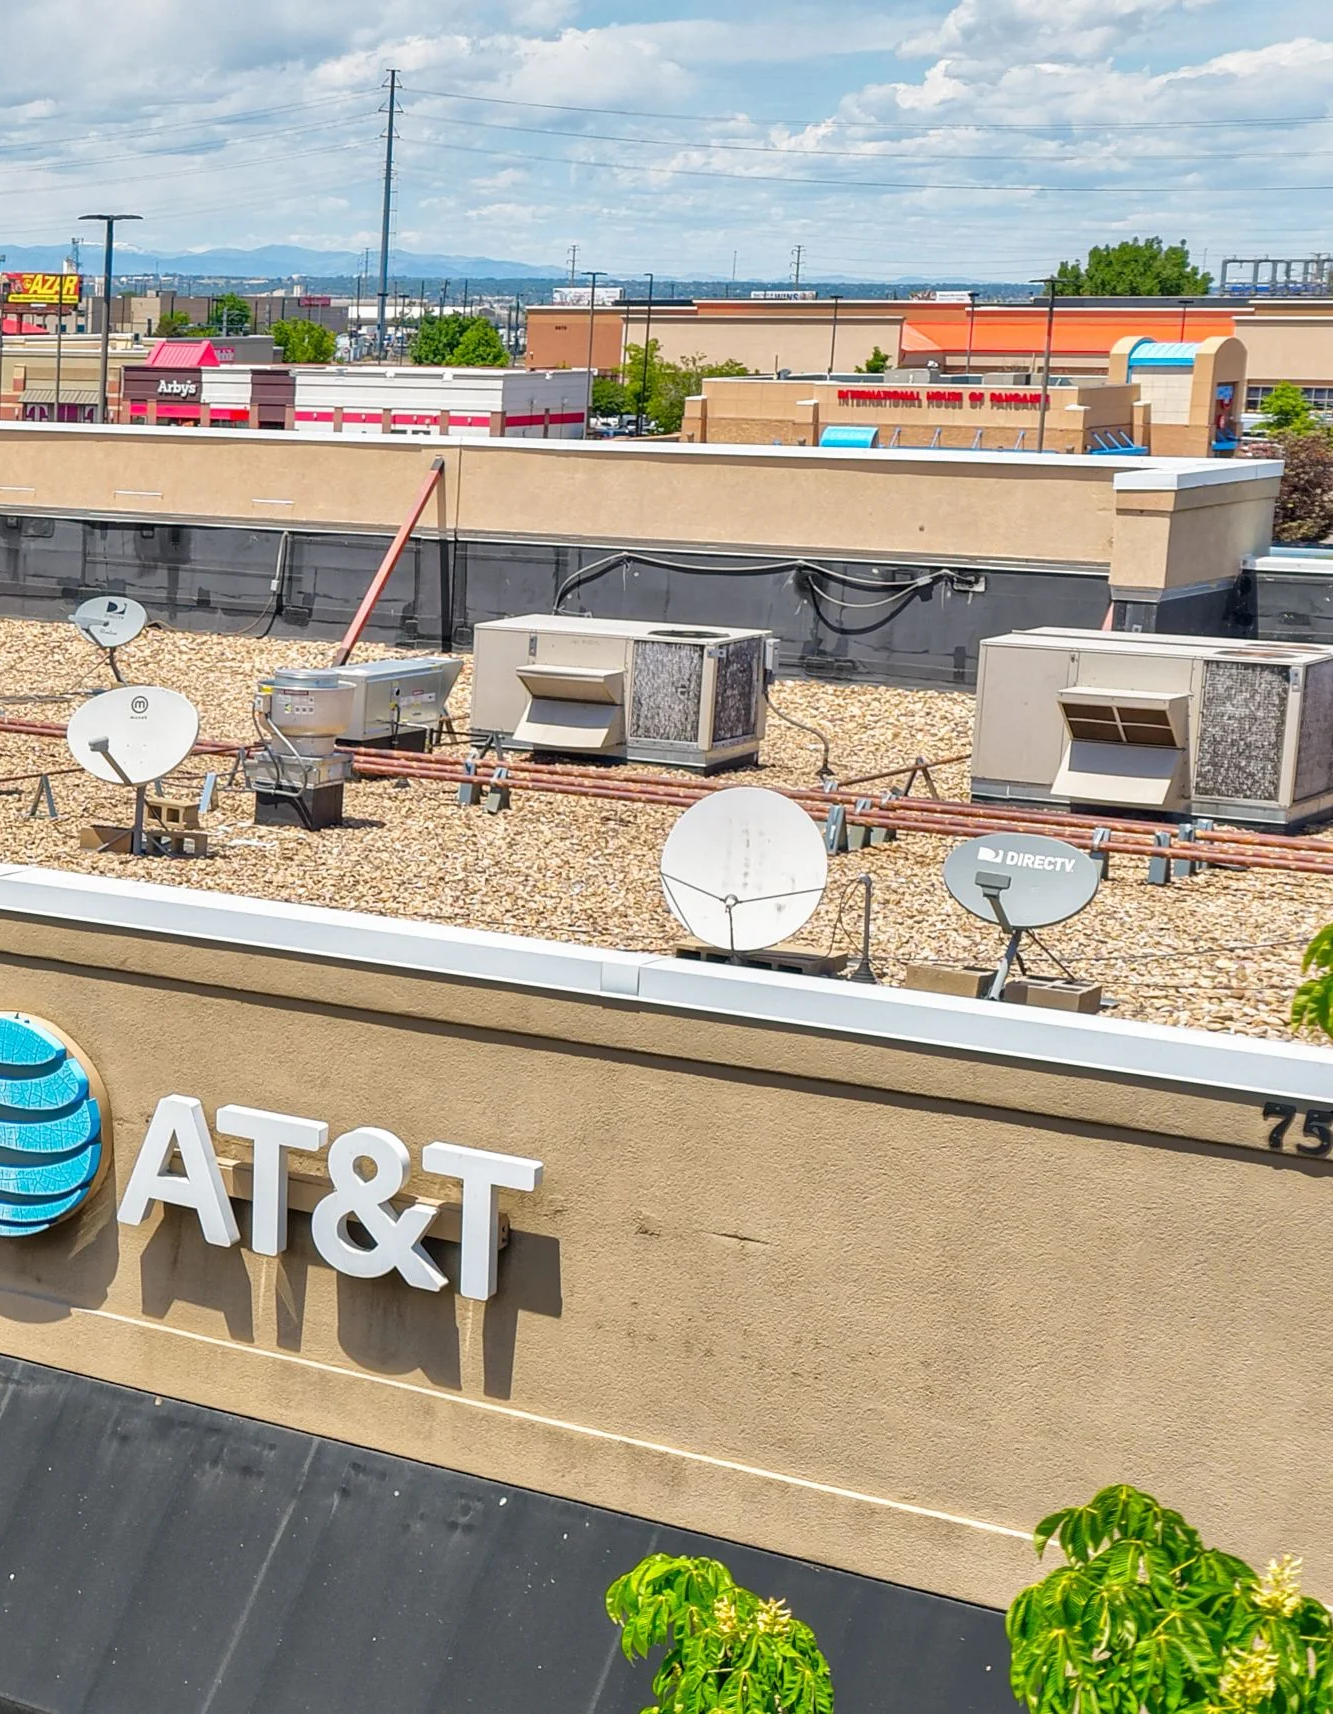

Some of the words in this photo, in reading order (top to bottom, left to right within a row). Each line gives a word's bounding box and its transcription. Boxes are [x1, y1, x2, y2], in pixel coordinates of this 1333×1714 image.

[157, 380, 196, 397] Arby's
[838, 389, 920, 400] INTERNATIONAL
[927, 391, 963, 402] HOUSE
[969, 392, 984, 402] OF
[1006, 851, 1075, 873] DIRECTV
[1263, 1101, 1332, 1155] 75
[117, 1094, 543, 1301] AT&T
